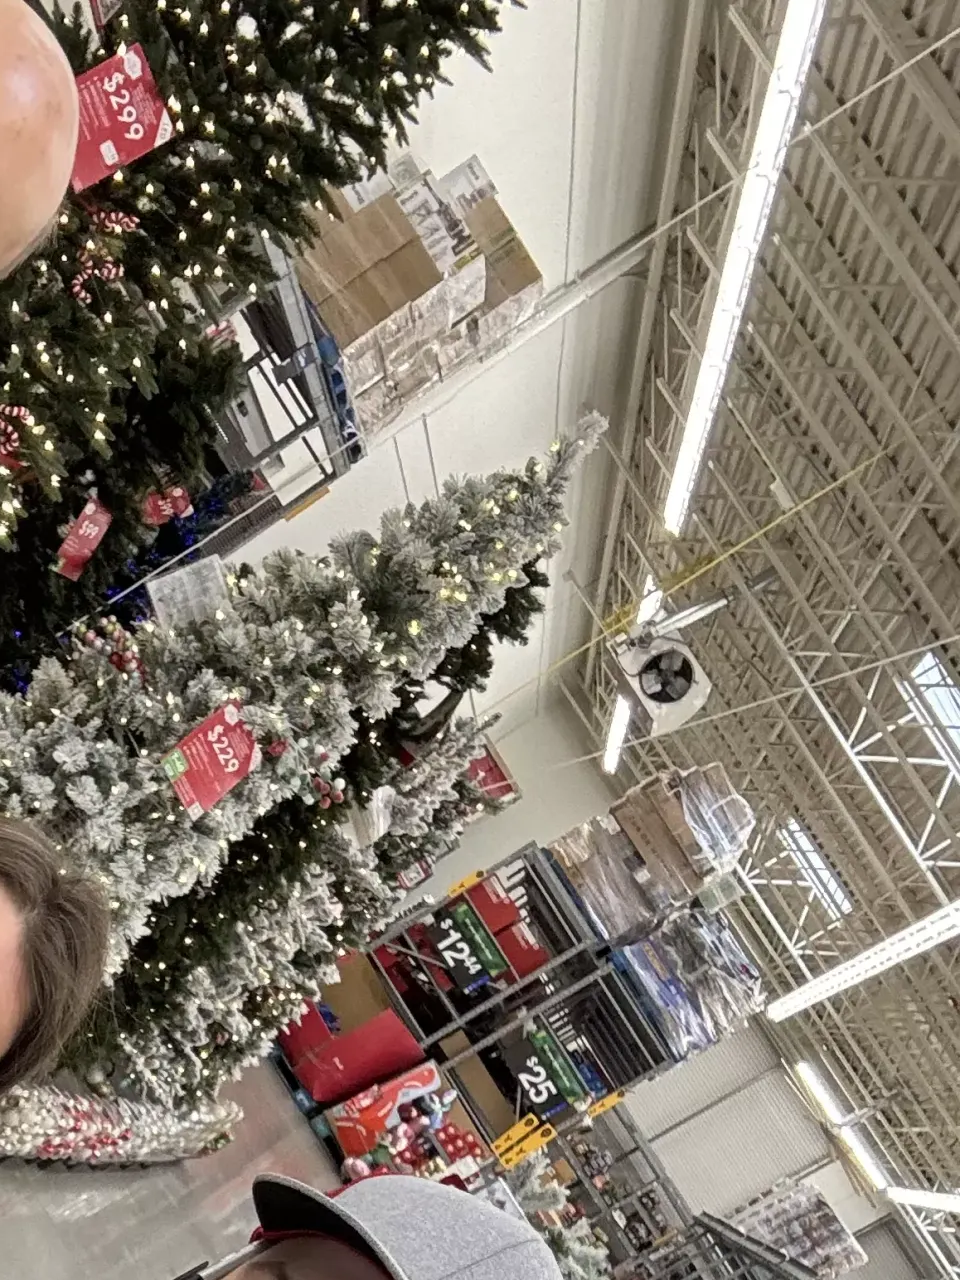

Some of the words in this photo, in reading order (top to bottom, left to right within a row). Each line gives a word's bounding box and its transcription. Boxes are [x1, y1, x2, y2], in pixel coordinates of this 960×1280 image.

[102, 72, 144, 140] $299
[206, 724, 240, 773] $229
[517, 1055, 558, 1104] $25
